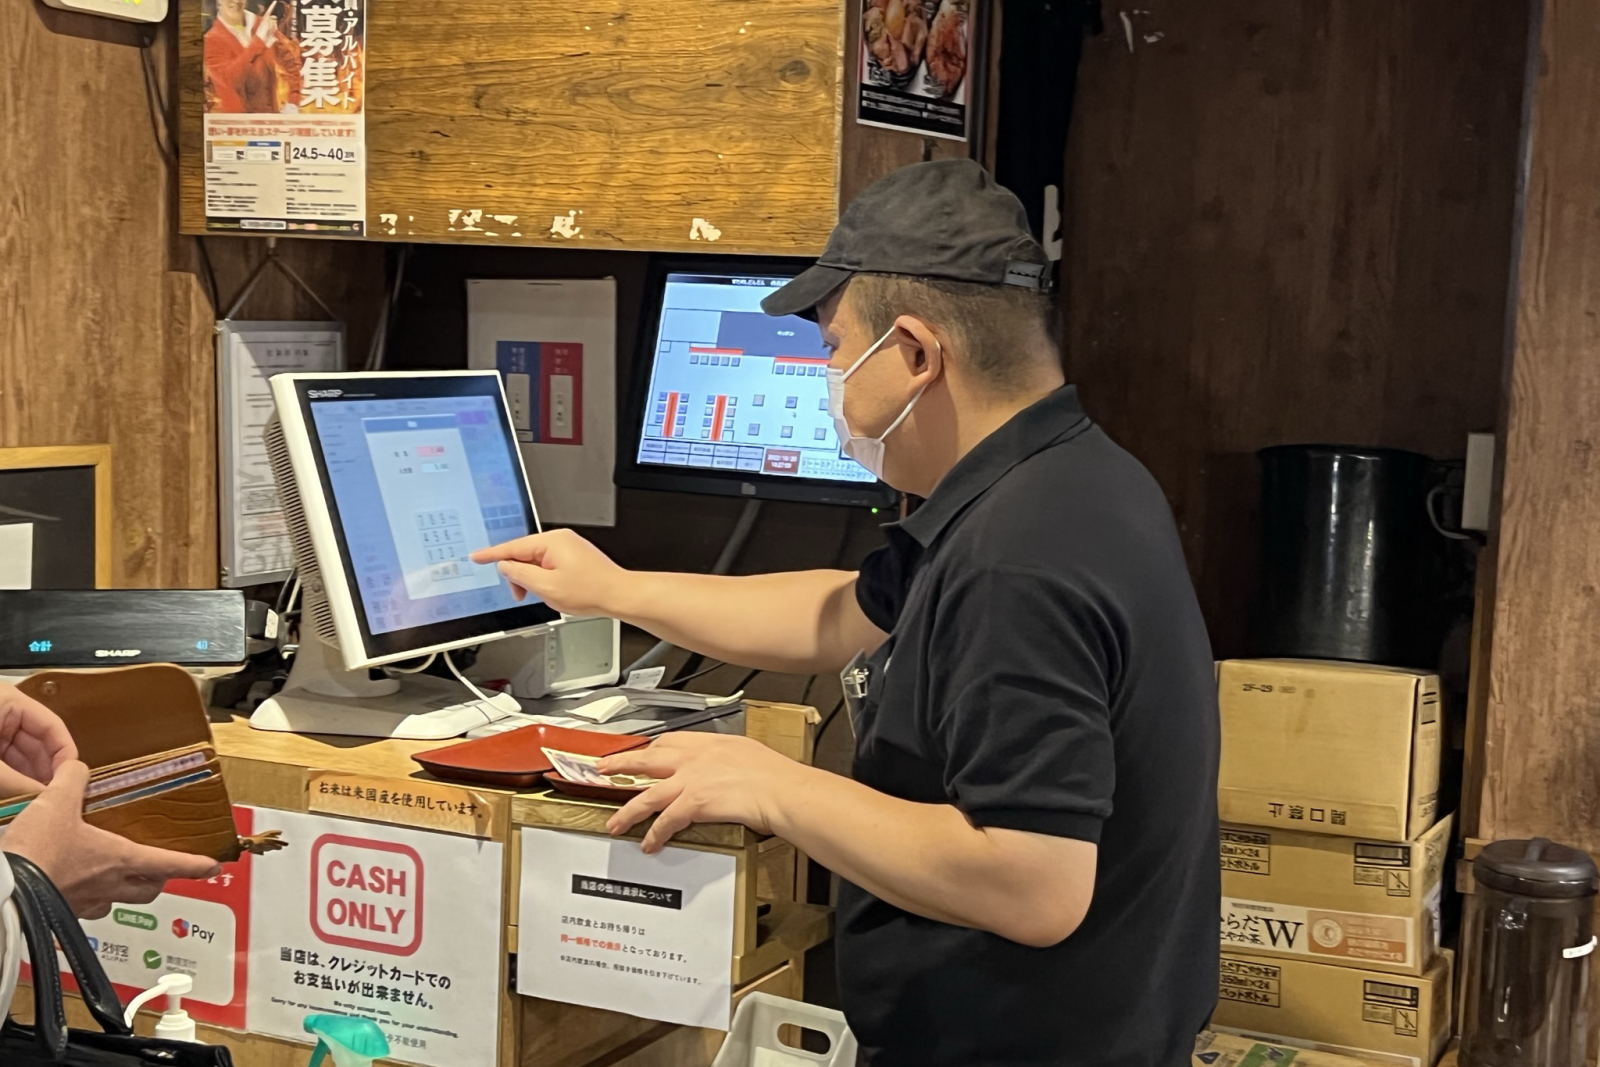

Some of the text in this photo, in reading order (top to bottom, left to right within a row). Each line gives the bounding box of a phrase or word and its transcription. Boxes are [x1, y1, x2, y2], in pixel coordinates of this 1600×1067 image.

[299, 0, 343, 109] 募集
[307, 389, 344, 399] SHARP
[95, 649, 141, 658] SHARP
[319, 781, 483, 819] お米は米国産を使用しています。
[327, 859, 406, 897] CASH
[327, 898, 406, 934] ONLY
[561, 915, 646, 936] 店内飲食とお持ち帰りは
[1220, 912, 1260, 932] らだ
[1258, 917, 1304, 948] W
[191, 925, 215, 943] Pay
[280, 946, 451, 990] 当店は、クレジットカードでの
[294, 970, 434, 1010] お支払いが出来ません。
